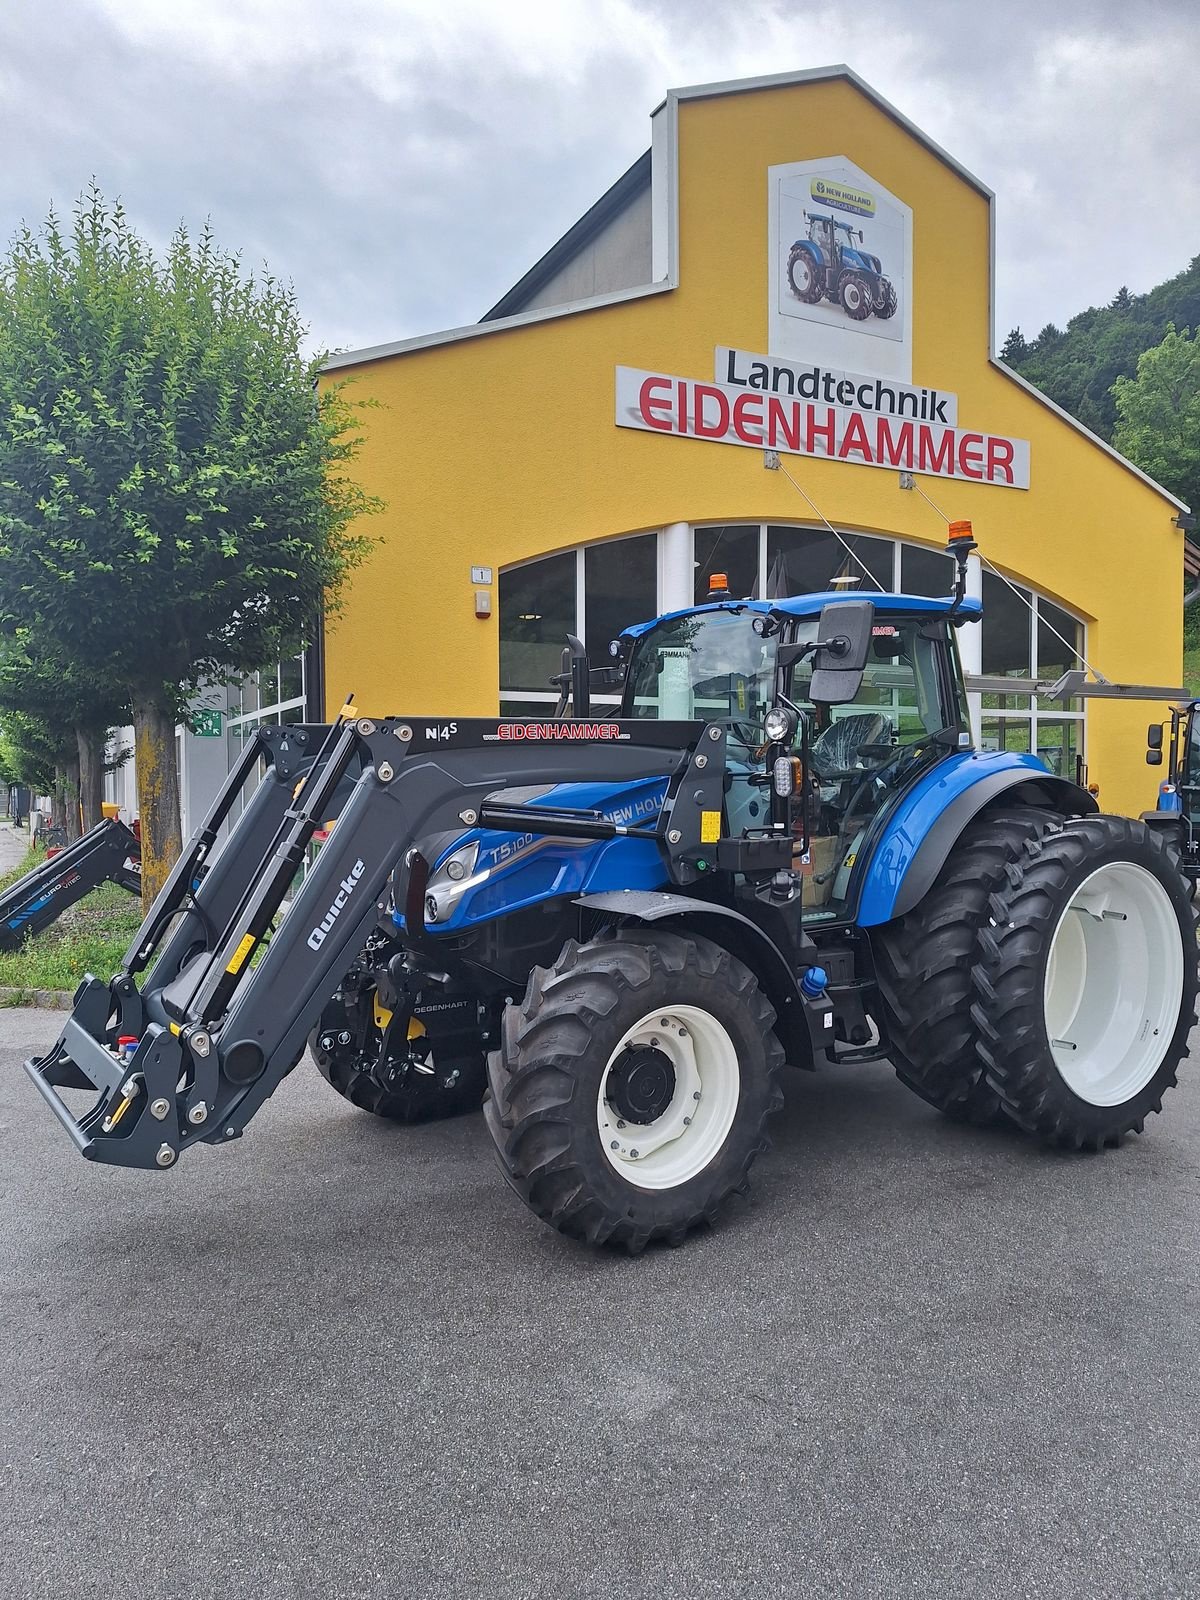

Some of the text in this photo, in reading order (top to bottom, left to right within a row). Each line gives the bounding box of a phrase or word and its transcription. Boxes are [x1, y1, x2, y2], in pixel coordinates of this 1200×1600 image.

[826, 187, 871, 206] NEW HOLLAND
[826, 199, 861, 213] AGRICULTURE
[726, 349, 948, 424] Landtechnik
[639, 376, 1014, 485] EIDENHAMMER
[603, 793, 666, 825] NEW HOLL
[490, 832, 533, 864] T5.100
[307, 859, 366, 951] Quicke
[414, 1001, 469, 1014] DEGENHART
